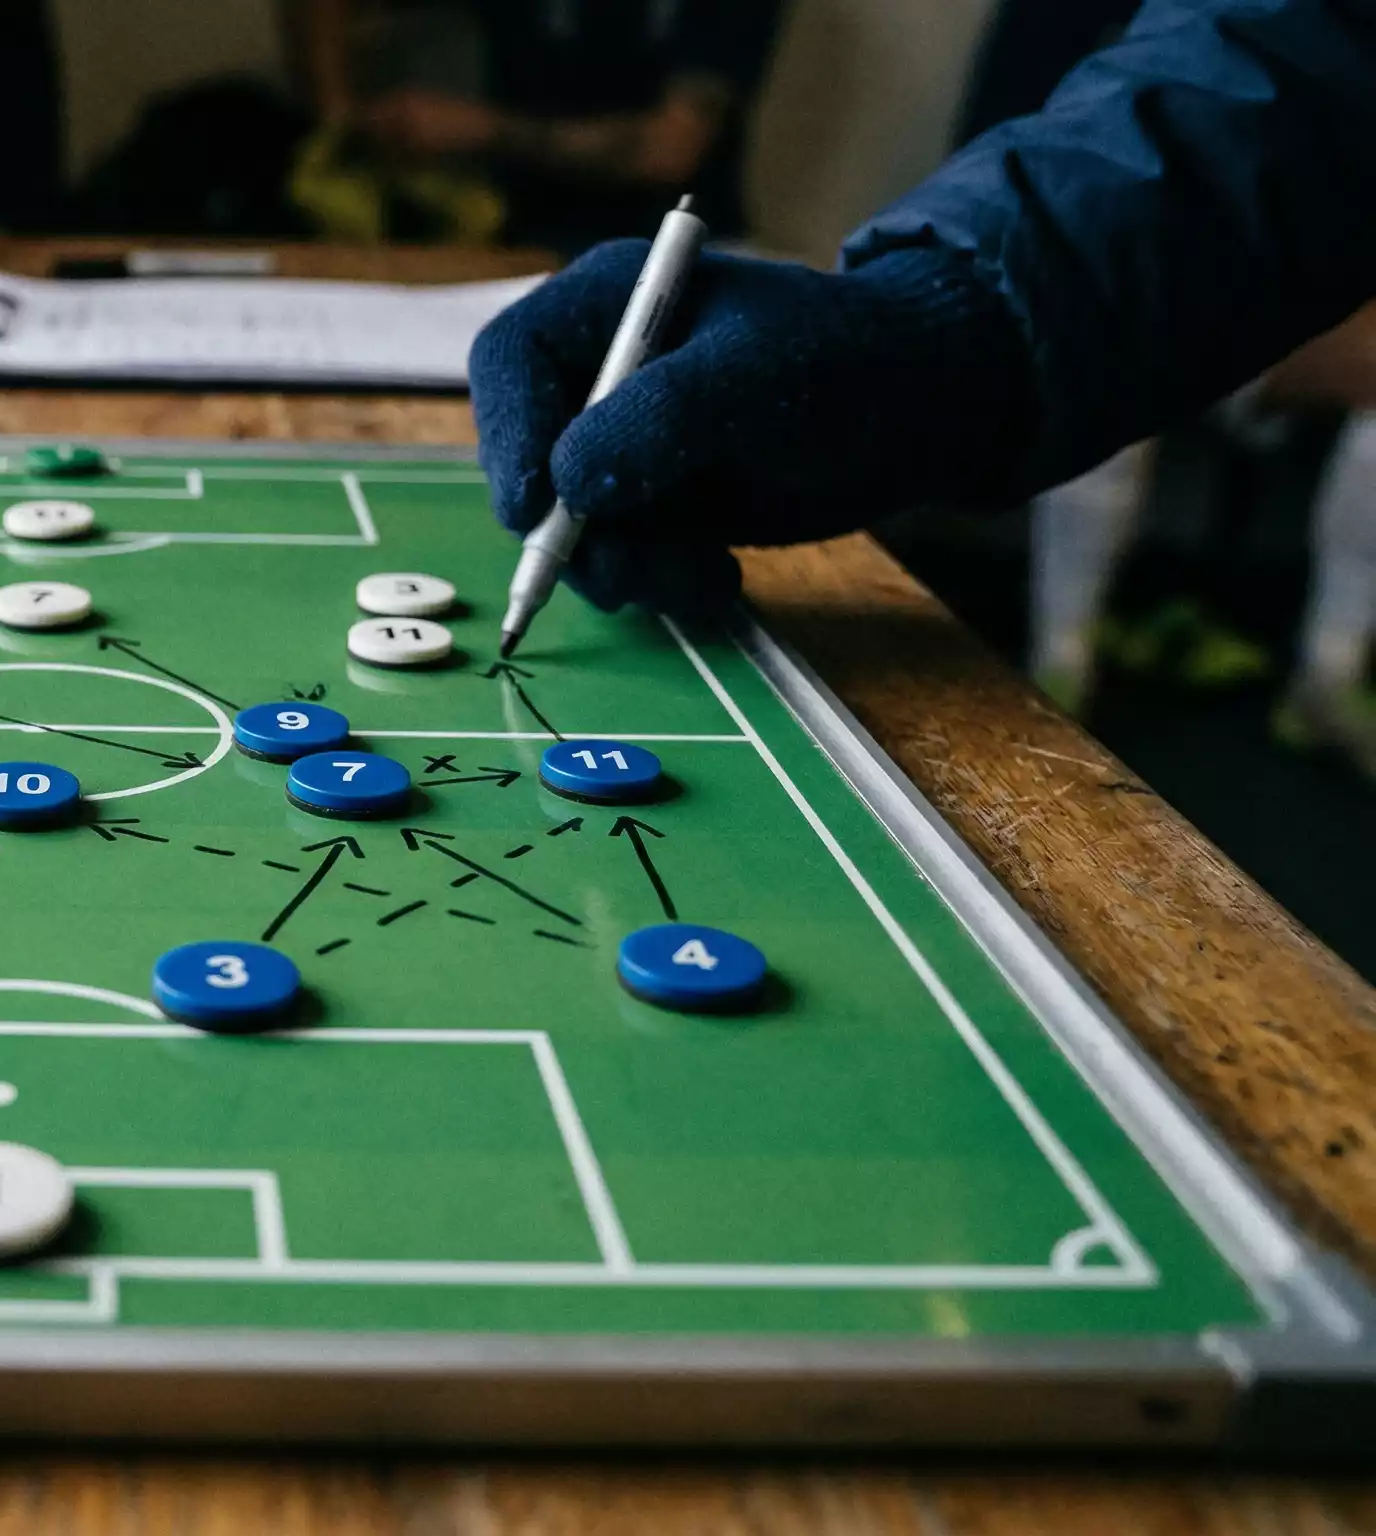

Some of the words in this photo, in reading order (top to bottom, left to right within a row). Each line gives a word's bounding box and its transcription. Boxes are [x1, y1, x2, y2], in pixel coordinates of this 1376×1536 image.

[376, 626, 422, 640] 11
[276, 711, 309, 730] 9
[571, 750, 630, 770] 11
[332, 762, 367, 782] 7
[671, 938, 720, 971] 4
[205, 954, 250, 989] 3
